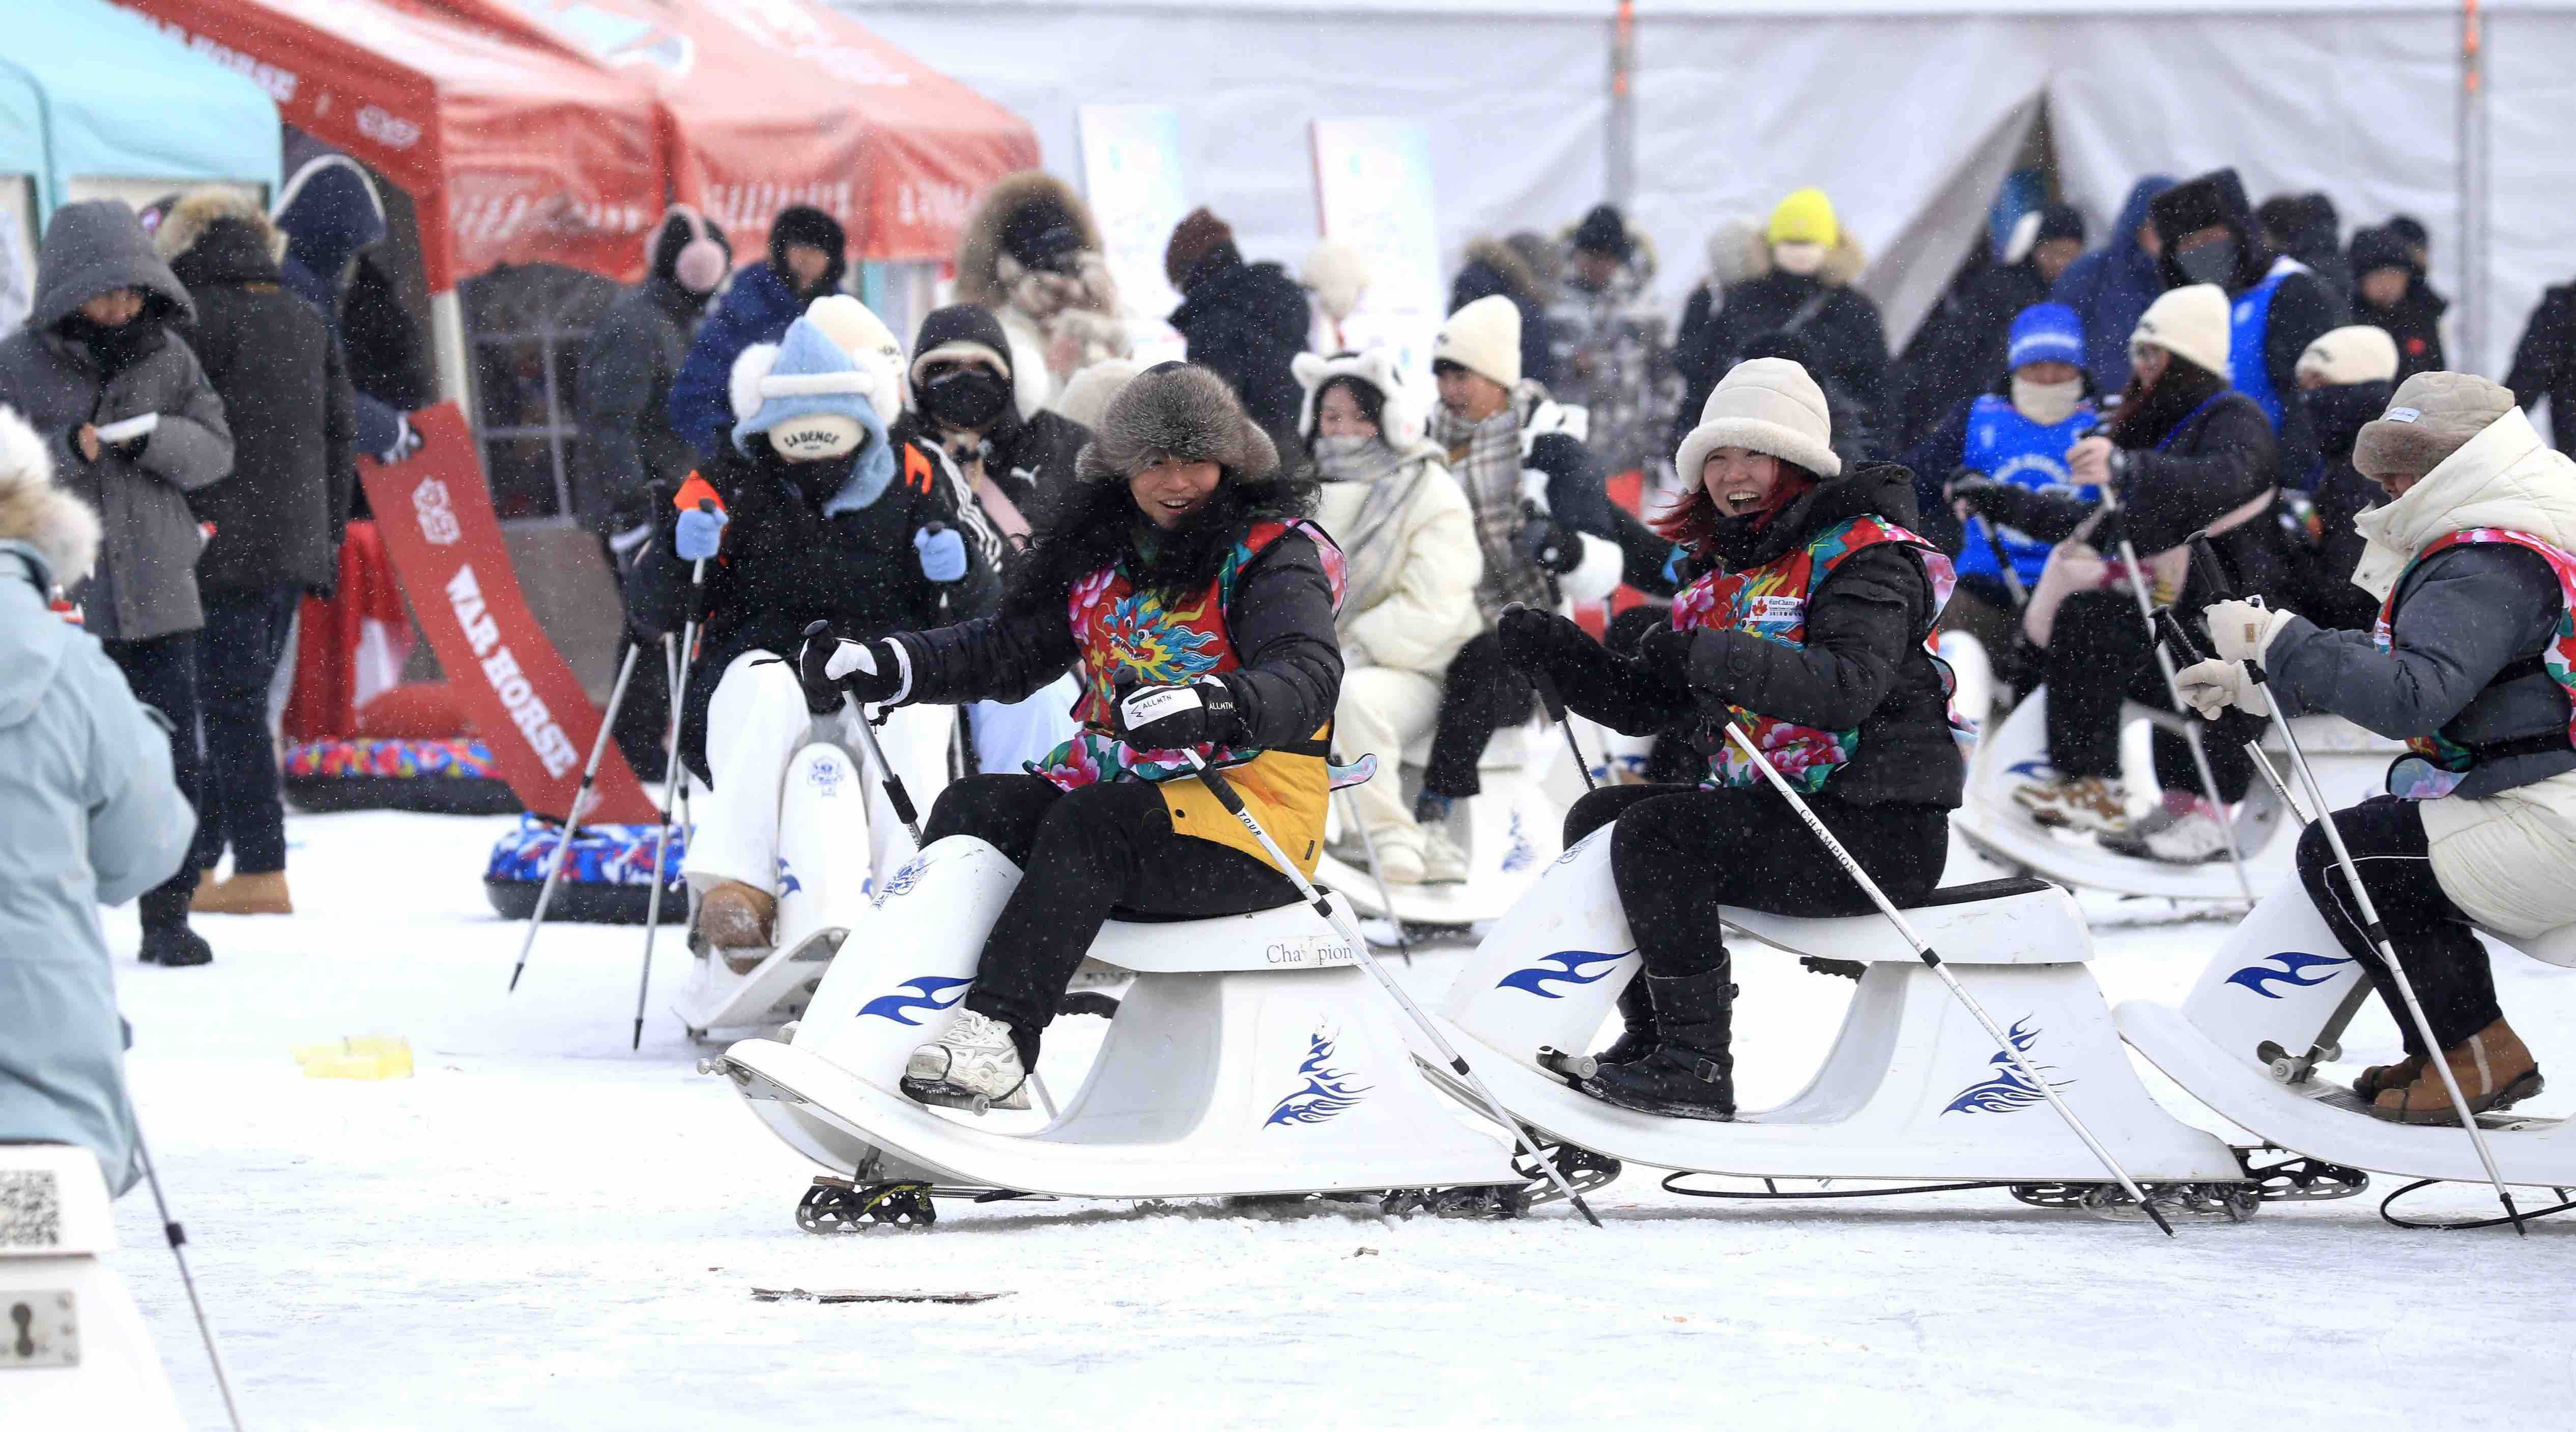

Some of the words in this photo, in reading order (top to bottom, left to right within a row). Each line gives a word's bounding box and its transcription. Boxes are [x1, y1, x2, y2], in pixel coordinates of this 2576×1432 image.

[446, 563, 499, 657] WAR
[480, 645, 579, 780] HORSE
[1142, 694, 1172, 709] ALLMTN
[1209, 701, 1233, 710] ALLMTN
[1239, 812, 1262, 836] TOUR
[1800, 809, 1856, 875] CHAMPION
[1266, 943, 1352, 966] Chapion
